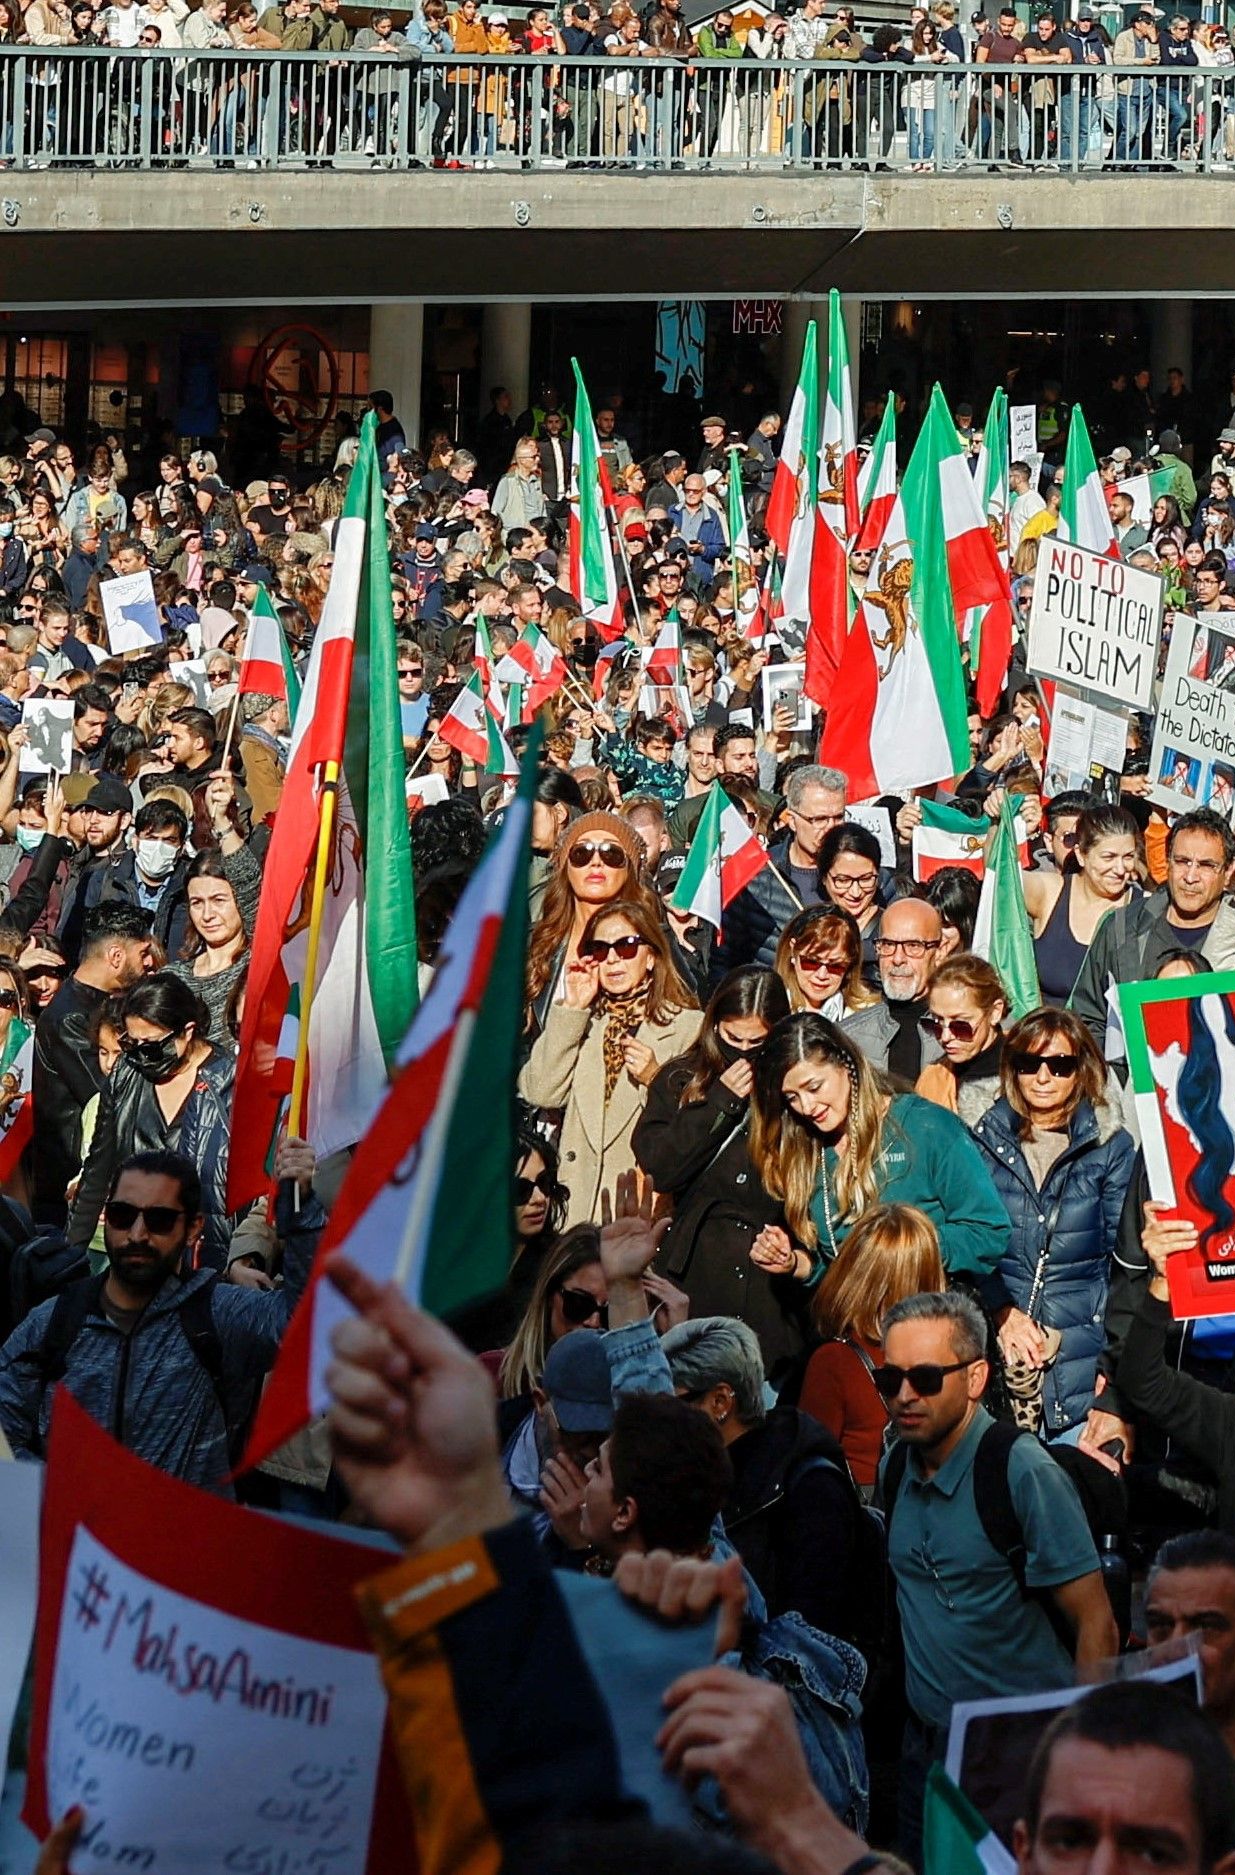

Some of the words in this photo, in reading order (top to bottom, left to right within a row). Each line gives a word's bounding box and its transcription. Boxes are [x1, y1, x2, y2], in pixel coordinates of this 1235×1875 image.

[1052, 548, 1084, 580] NO
[1092, 557, 1125, 595] TO
[1045, 573, 1154, 647] POLITICAL
[1056, 626, 1141, 695] ISLAM
[1161, 708, 1183, 738] the
[1175, 677, 1226, 720] Death
[73, 1562, 334, 1727] #MahsaAmini
[64, 1682, 196, 1772] Women
